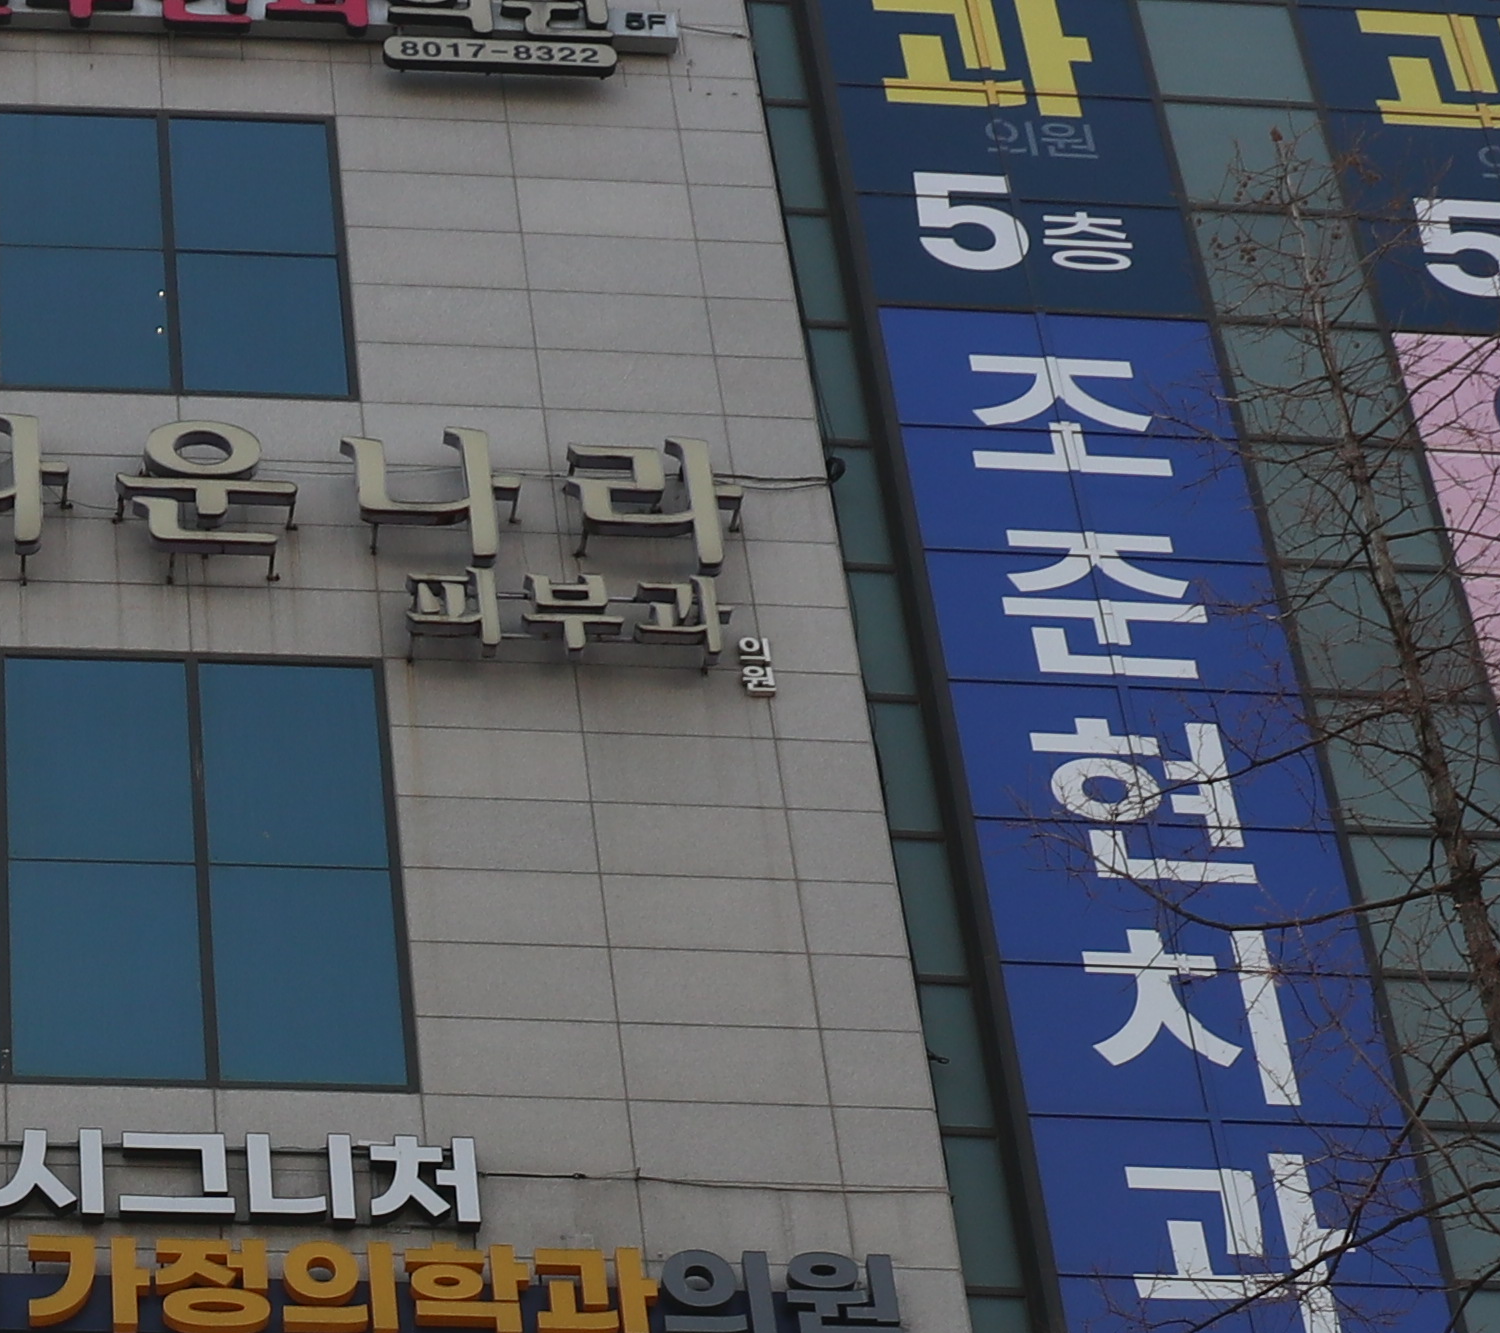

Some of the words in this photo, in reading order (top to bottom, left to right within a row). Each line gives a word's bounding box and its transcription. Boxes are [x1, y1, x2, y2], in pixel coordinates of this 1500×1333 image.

[624, 12, 667, 31] 5F
[400, 40, 600, 64] 8017-8322
[985, 119, 1098, 159] 의원
[913, 171, 1133, 271] 5층
[406, 566, 732, 662] 피부과
[738, 636, 776, 698] 의원
